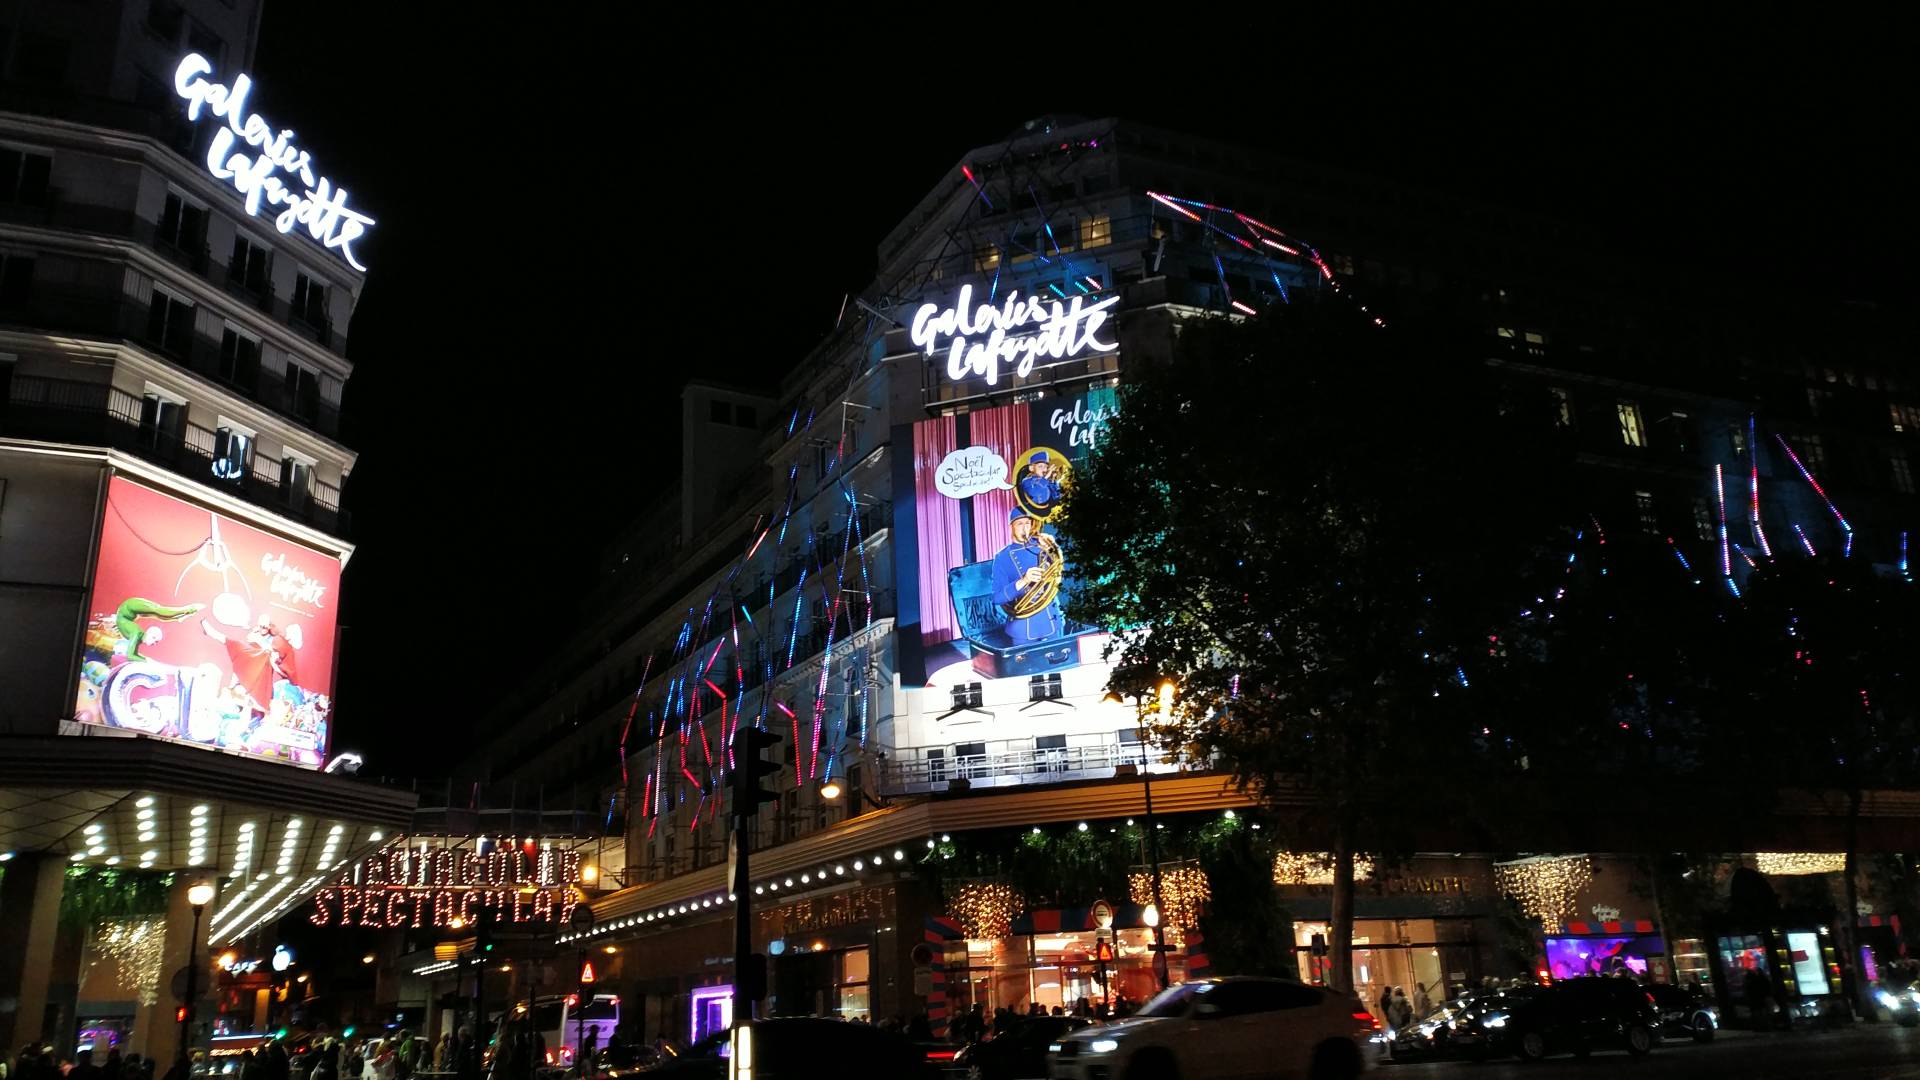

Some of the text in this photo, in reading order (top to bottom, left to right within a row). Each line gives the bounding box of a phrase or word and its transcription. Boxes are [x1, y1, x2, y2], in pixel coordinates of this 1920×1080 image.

[174, 53, 314, 188] Galeries
[207, 126, 376, 272] Lafayette
[911, 284, 1050, 356] Galeries
[947, 296, 1120, 386] Lafayette
[340, 847, 581, 889] ECTACULAR
